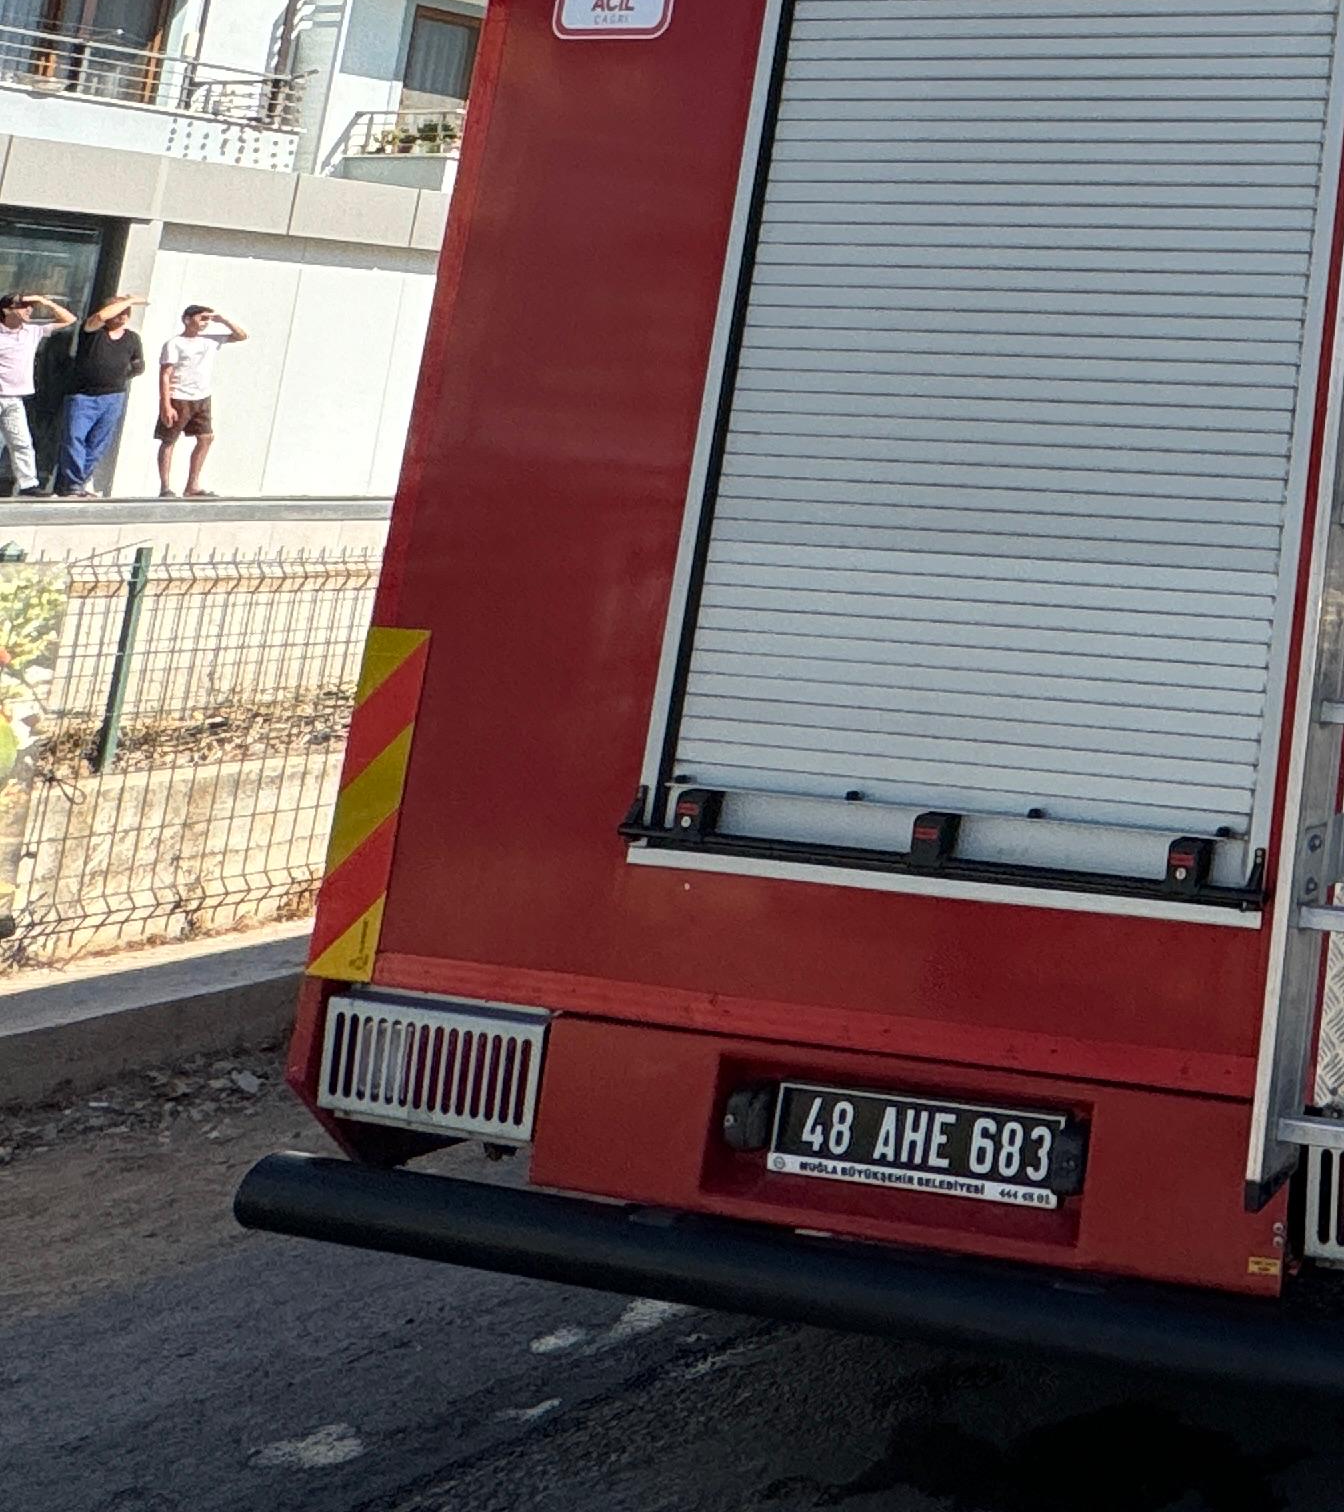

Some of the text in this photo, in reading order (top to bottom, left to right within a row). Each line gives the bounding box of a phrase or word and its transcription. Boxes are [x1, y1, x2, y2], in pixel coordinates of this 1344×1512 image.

[801, 1097, 1053, 1182] 48 AHE 683
